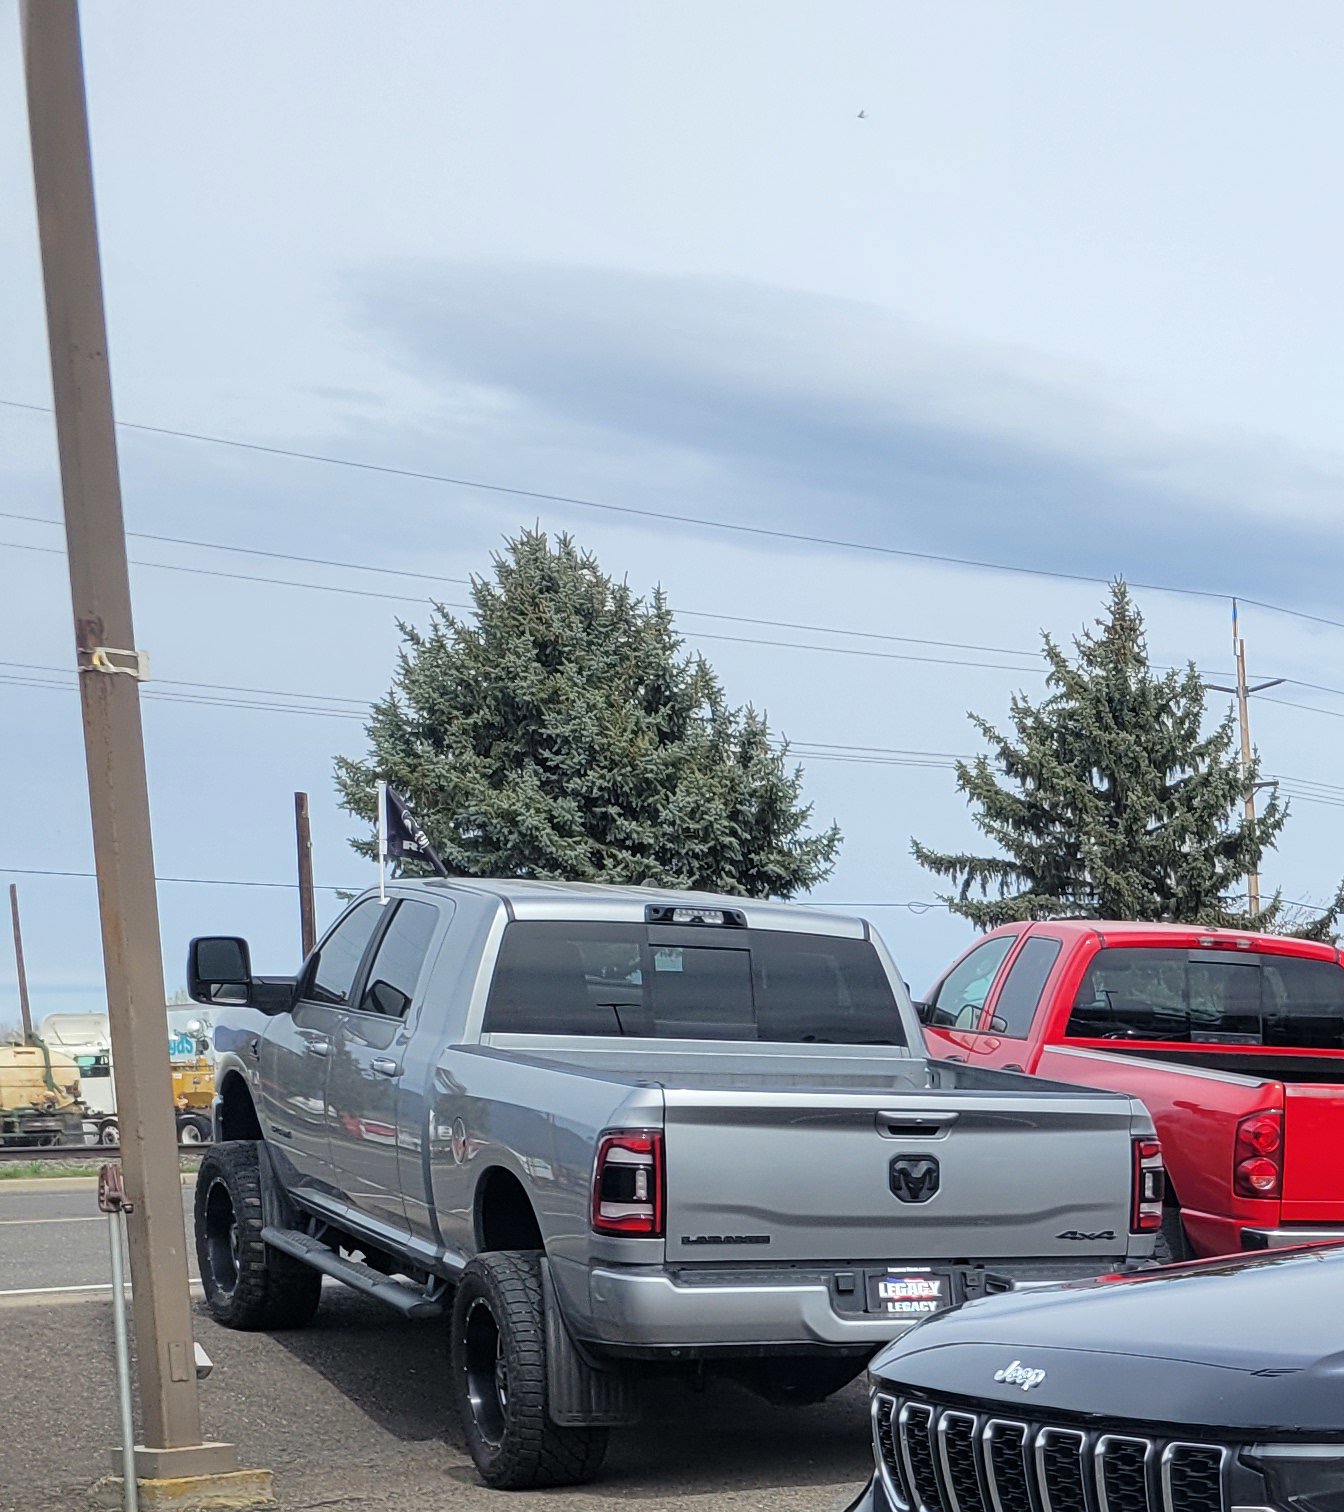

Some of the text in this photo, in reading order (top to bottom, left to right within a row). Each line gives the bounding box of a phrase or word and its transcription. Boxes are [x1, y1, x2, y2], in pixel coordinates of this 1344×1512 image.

[878, 1280, 941, 1298] LEGACY
[887, 1301, 937, 1312] LEGACY
[993, 1360, 1046, 1391] Jeep
